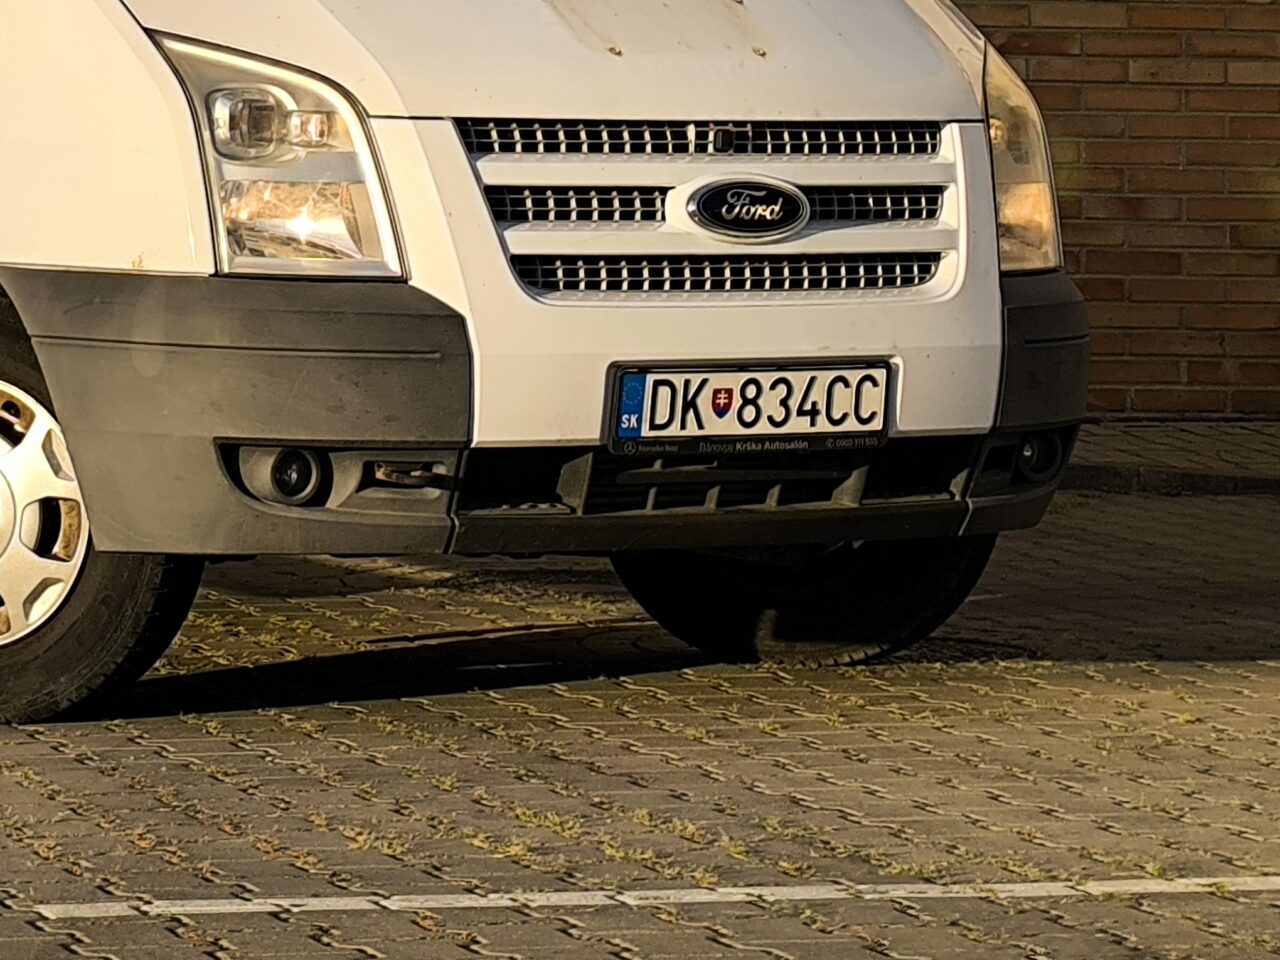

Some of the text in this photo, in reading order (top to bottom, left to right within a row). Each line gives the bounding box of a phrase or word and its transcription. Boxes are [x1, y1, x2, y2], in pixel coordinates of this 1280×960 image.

[721, 188, 784, 221] Ford
[648, 373, 880, 431] DK 834CC
[621, 413, 639, 429] SK
[735, 441, 762, 451] Krška
[763, 439, 809, 450] Autosalón
